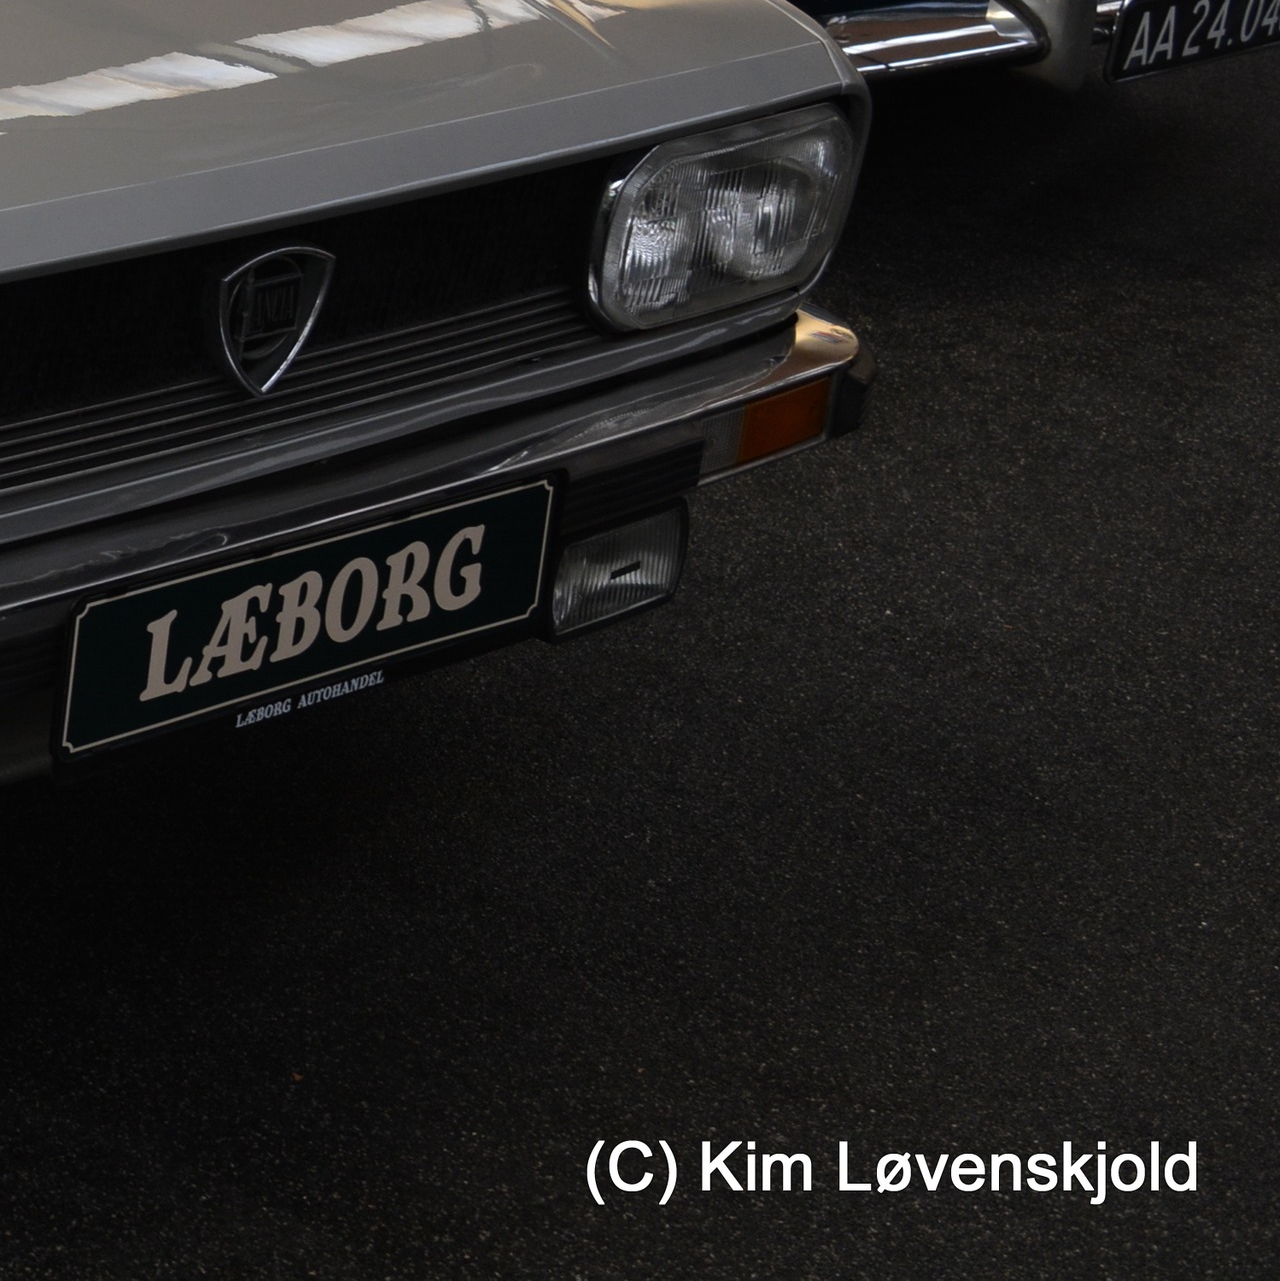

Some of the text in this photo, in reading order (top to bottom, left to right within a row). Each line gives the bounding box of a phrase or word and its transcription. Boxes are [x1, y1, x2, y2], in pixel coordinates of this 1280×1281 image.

[1122, 5, 1177, 71] AA
[139, 523, 487, 702] LÆBORG
[234, 670, 385, 730] LÆBORG AUTOHANDEL
